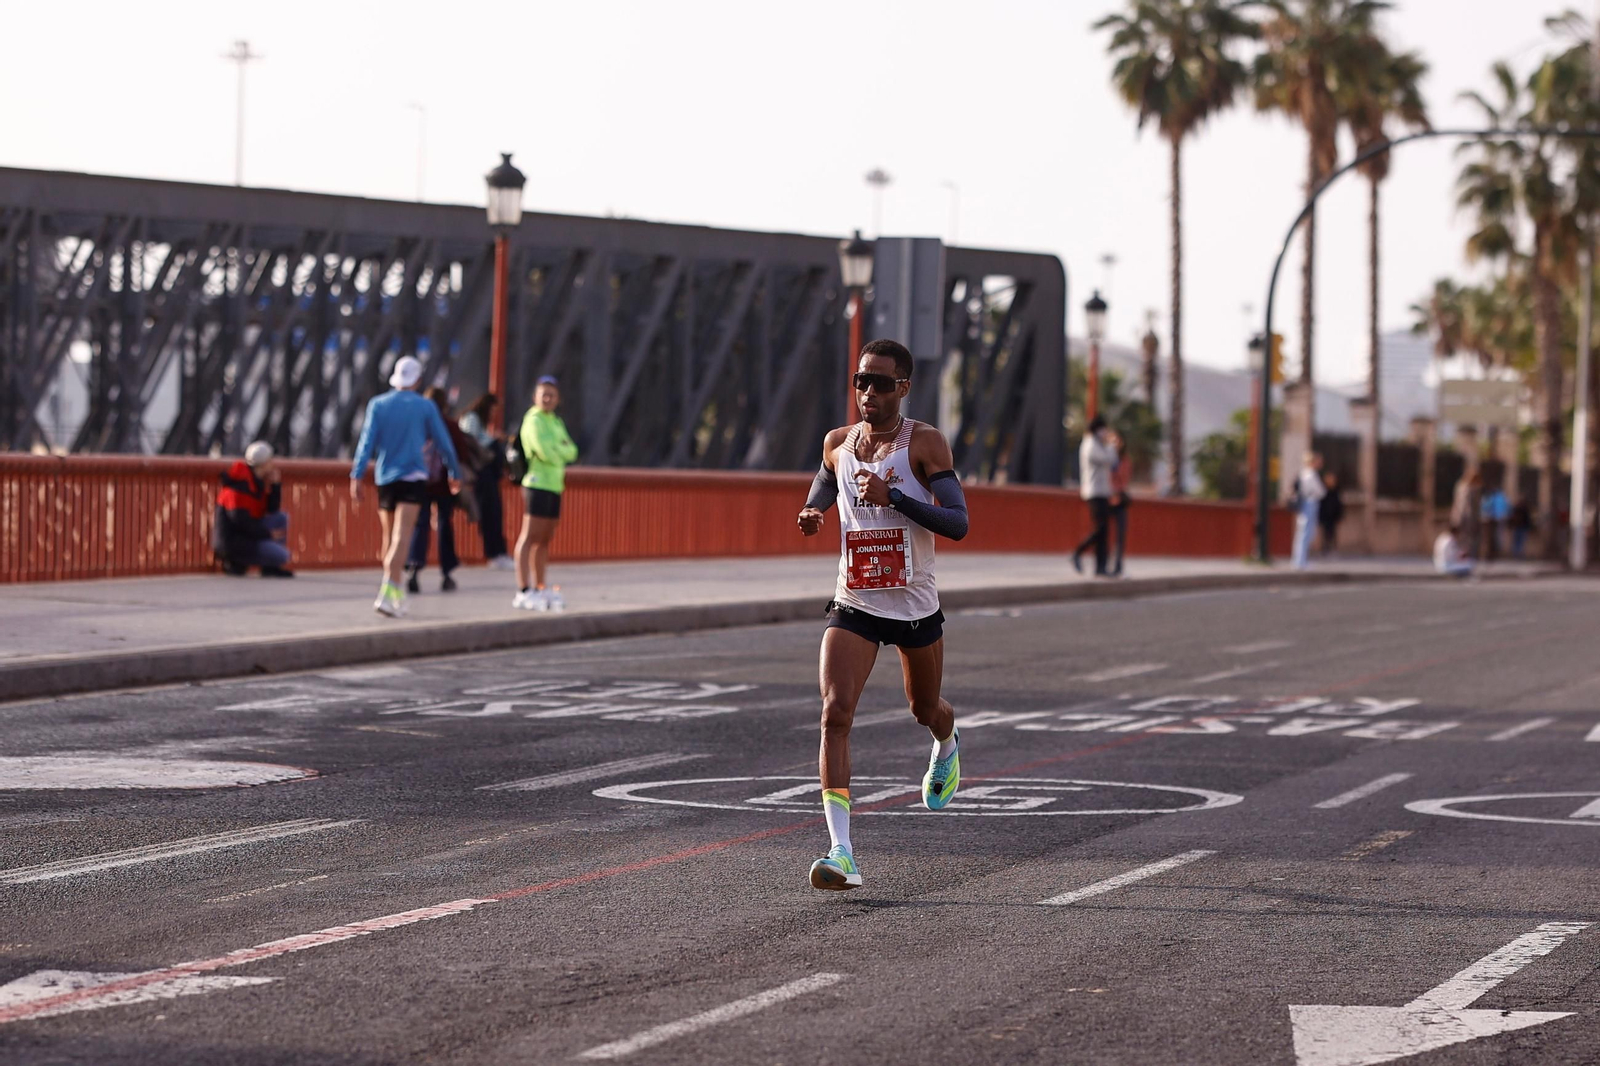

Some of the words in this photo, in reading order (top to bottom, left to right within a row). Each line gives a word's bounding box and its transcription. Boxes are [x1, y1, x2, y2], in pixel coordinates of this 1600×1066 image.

[858, 530, 898, 540] GENERALI
[856, 545, 893, 554] JONATHAN
[870, 556, 878, 564] 18
[743, 782, 1092, 810] 50
